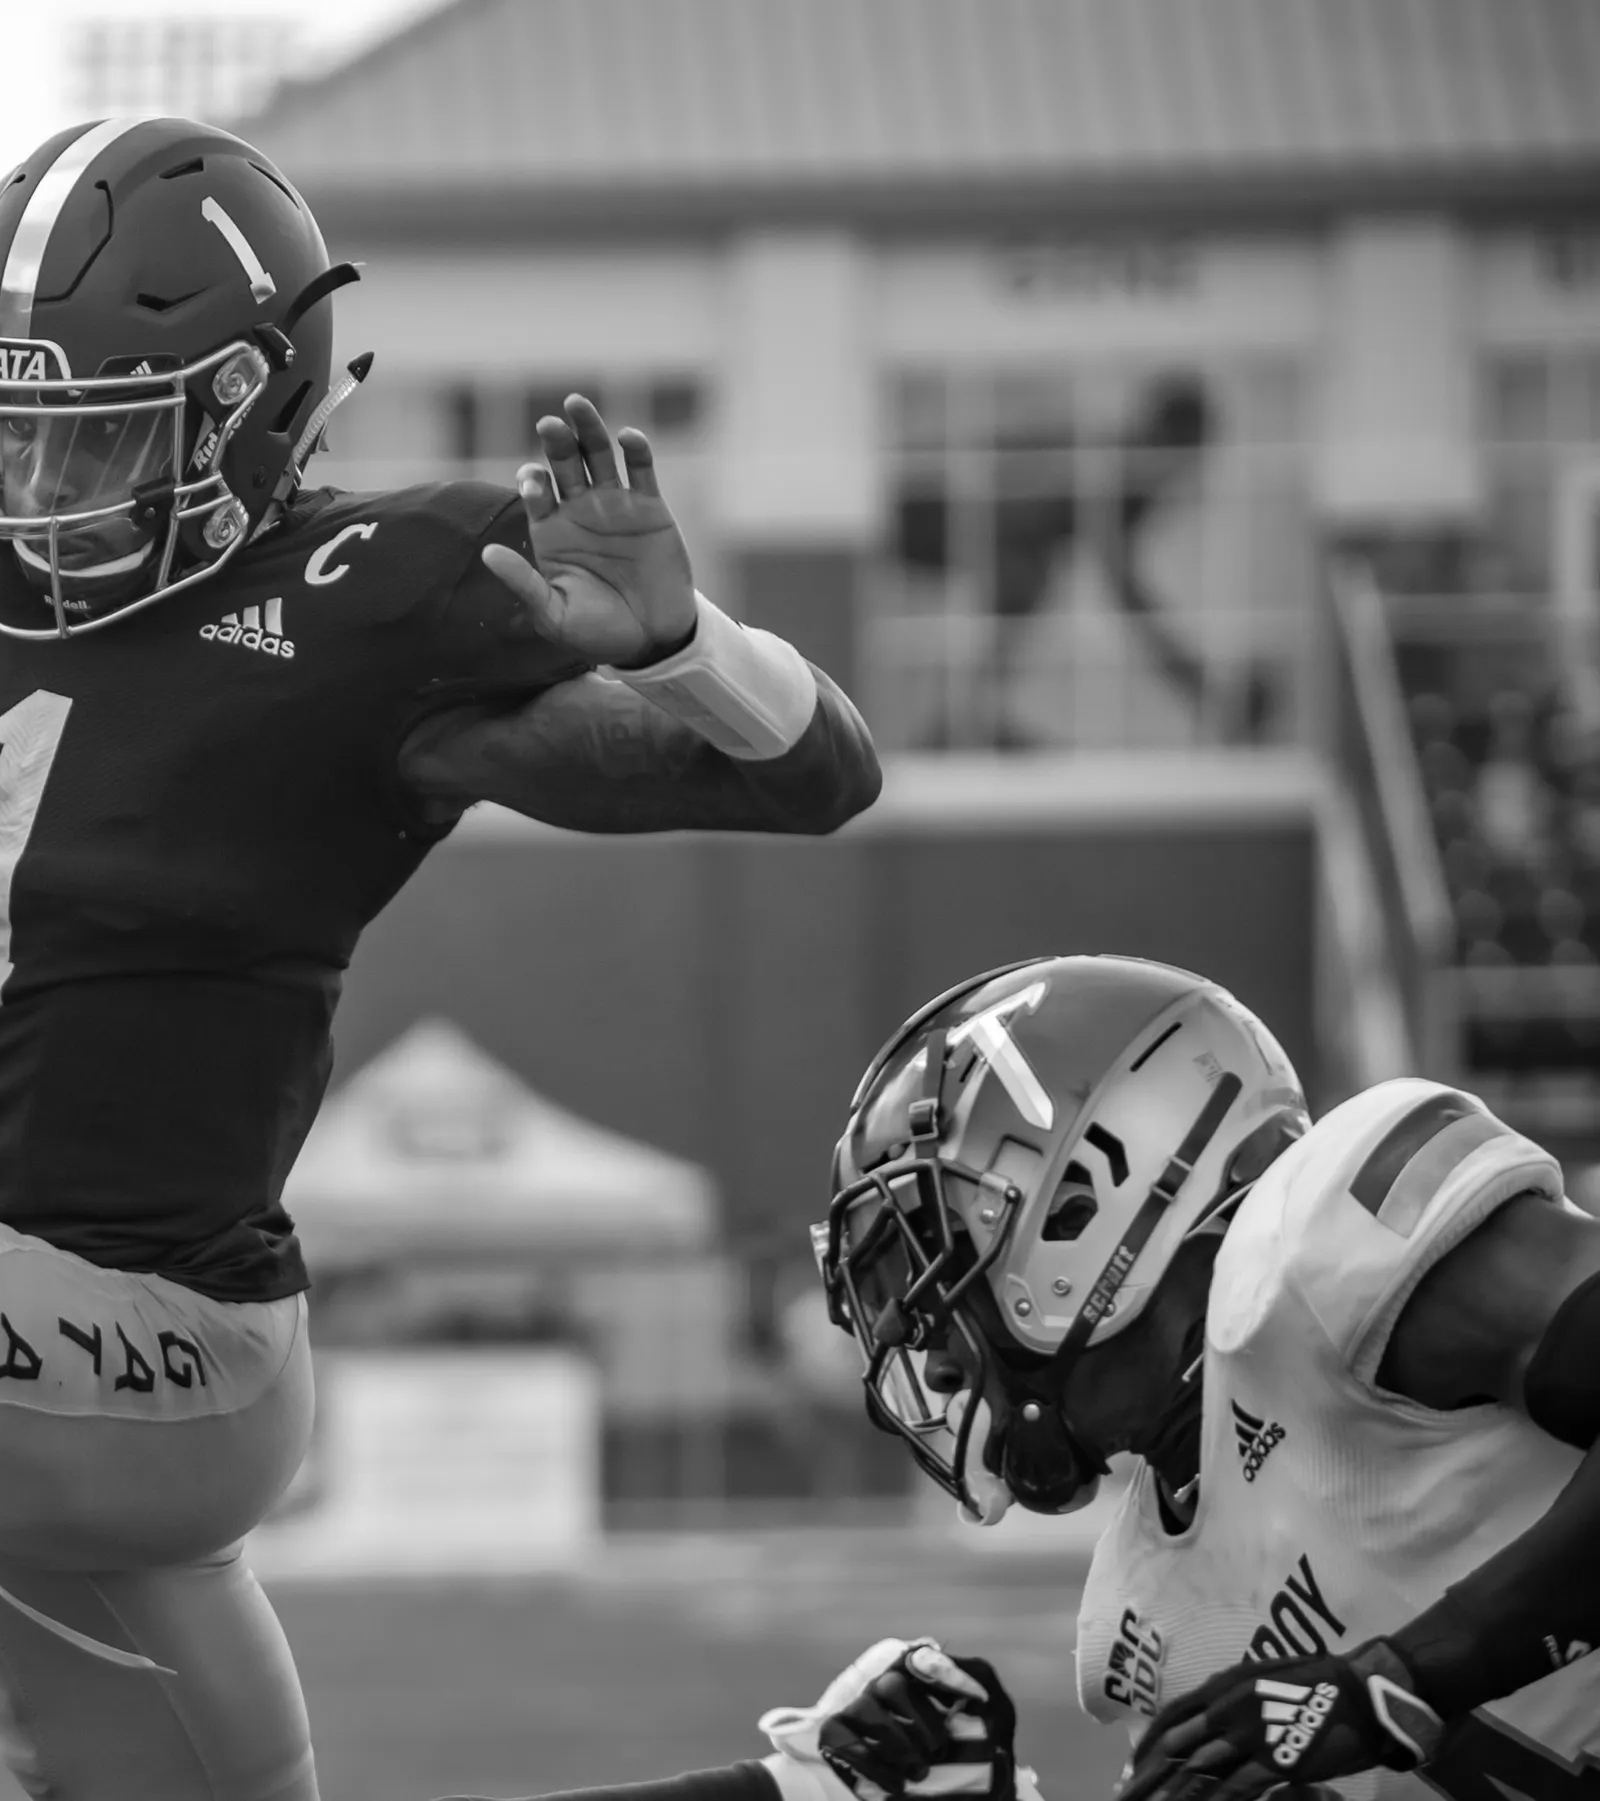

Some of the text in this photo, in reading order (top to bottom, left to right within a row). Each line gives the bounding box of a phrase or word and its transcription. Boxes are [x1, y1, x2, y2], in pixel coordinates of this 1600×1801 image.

[201, 196, 277, 305] 1
[304, 522, 379, 585] C
[199, 623, 295, 658] adidas
[1243, 1422, 1286, 1482] adidas
[1241, 1553, 1347, 1663] ROY
[1272, 1682, 1340, 1767] adidas
